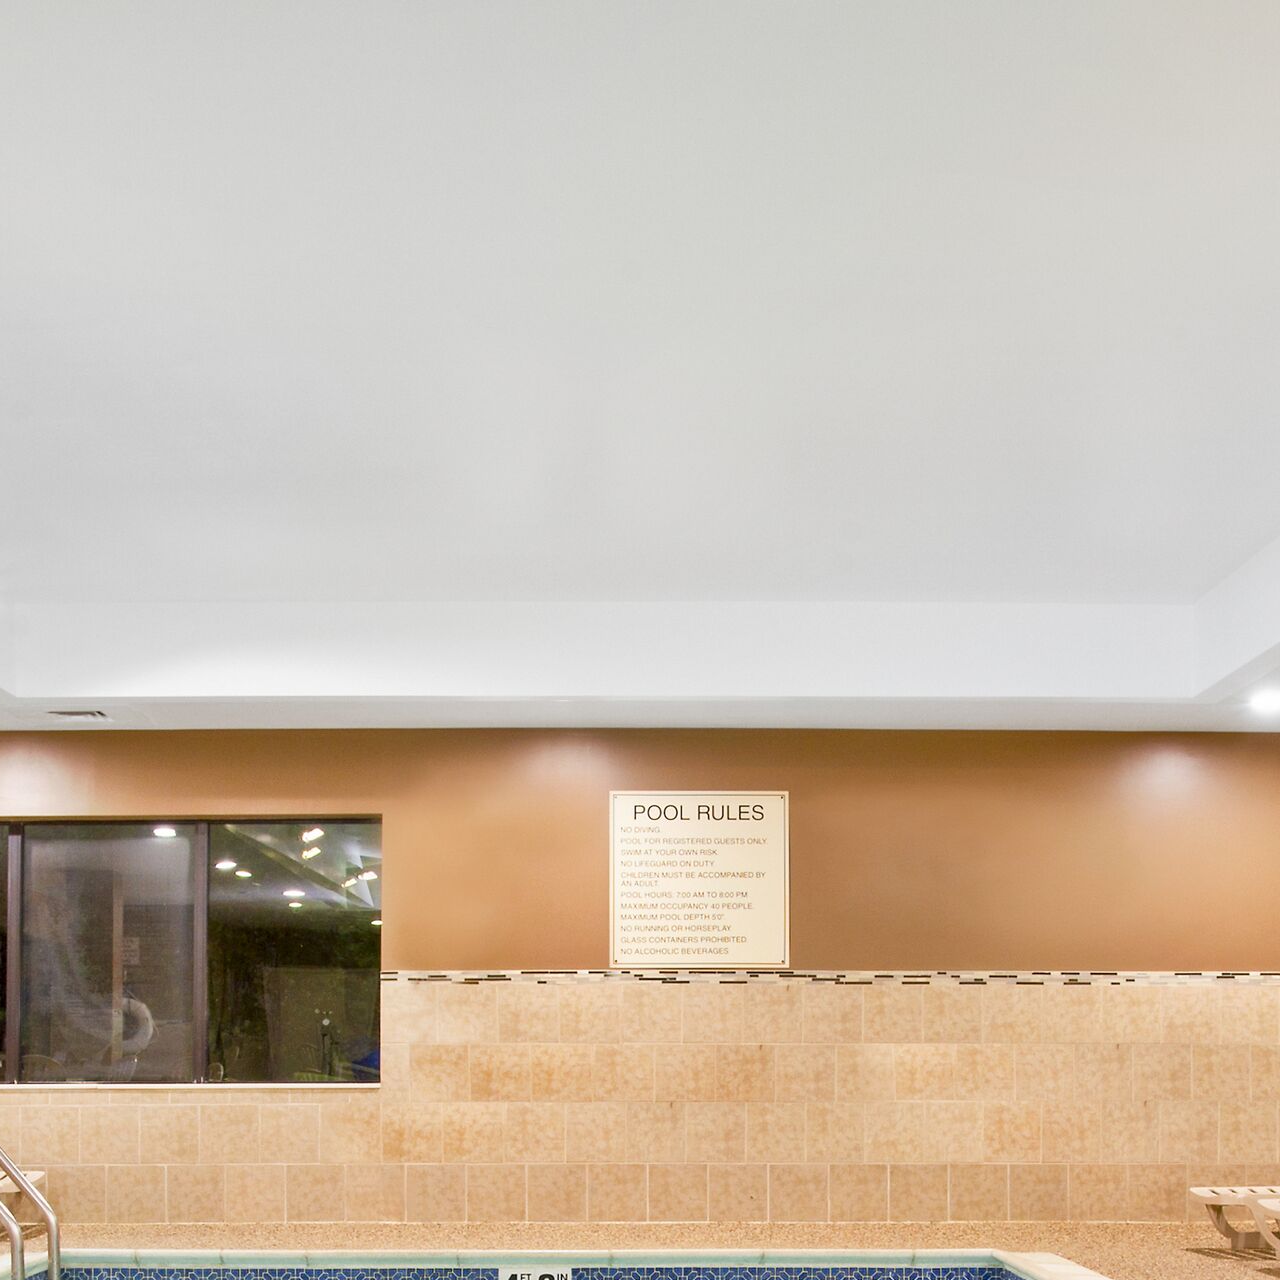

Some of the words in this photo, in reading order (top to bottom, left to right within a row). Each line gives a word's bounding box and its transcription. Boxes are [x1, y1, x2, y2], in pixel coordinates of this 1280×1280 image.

[633, 804, 690, 821] POOL
[697, 804, 765, 821] RULES
[620, 837, 641, 845] POOL
[644, 837, 661, 845] FOR
[662, 837, 712, 845] REGISTERED
[714, 837, 745, 845] GUESTS
[621, 848, 641, 856] SWIM
[643, 848, 653, 856] AT
[655, 848, 677, 856] YOUR
[678, 848, 698, 856] OWN
[620, 871, 660, 879] CHILDREN
[661, 871, 683, 879] MUST
[685, 871, 696, 879] BE
[698, 871, 754, 879] ACCOMPANIED
[756, 871, 766, 879] BY
[620, 891, 642, 899] POOL
[692, 891, 705, 899] AM
[707, 891, 718, 899] TO
[620, 902, 658, 910] MAXIMUM
[660, 902, 709, 910] OCCUPANCY
[621, 947, 632, 955] NO
[634, 947, 680, 955] ALCOHOLIC
[681, 947, 729, 955] BEVERAGES
